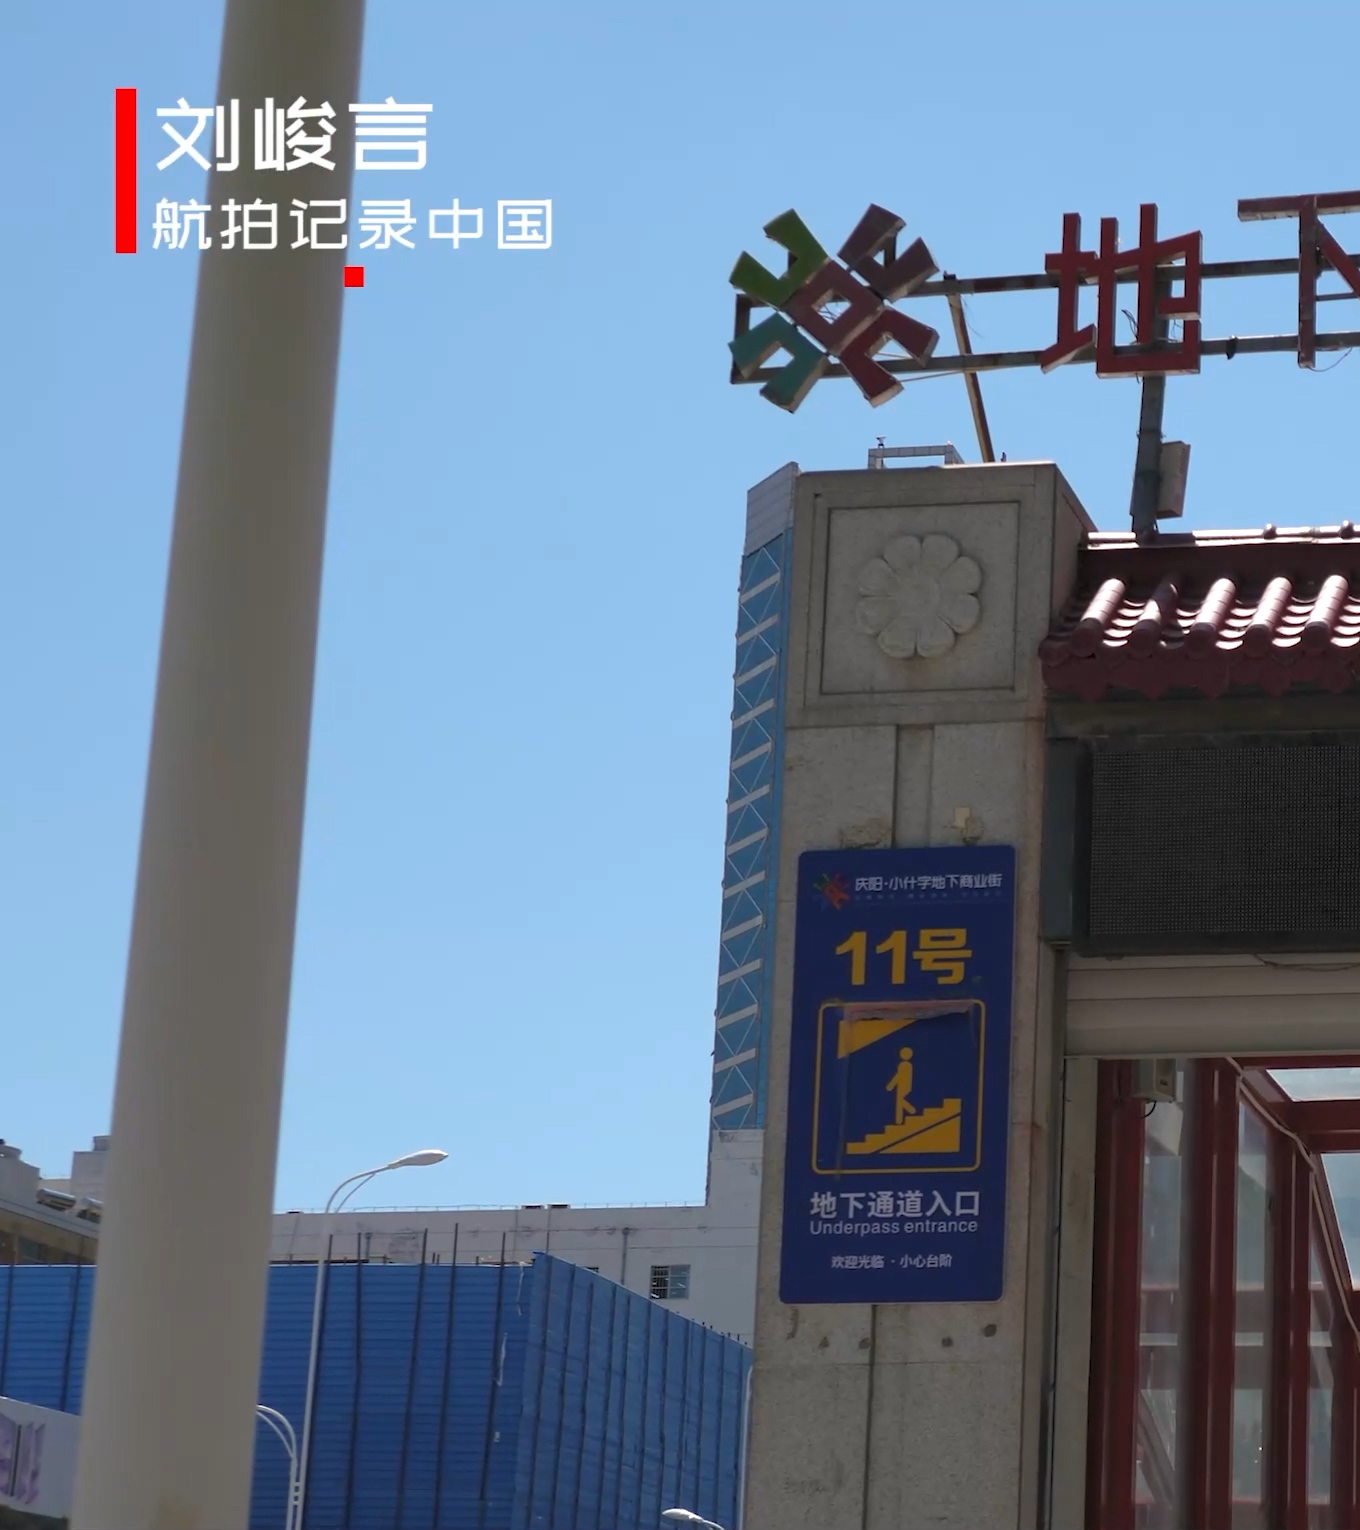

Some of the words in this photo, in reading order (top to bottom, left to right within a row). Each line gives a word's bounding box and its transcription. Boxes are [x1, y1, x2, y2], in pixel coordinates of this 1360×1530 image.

[835, 928, 973, 986] 11号
[809, 1190, 981, 1219] 地下通道入口
[809, 1220, 900, 1237] Underpass
[904, 1219, 978, 1234] entrance
